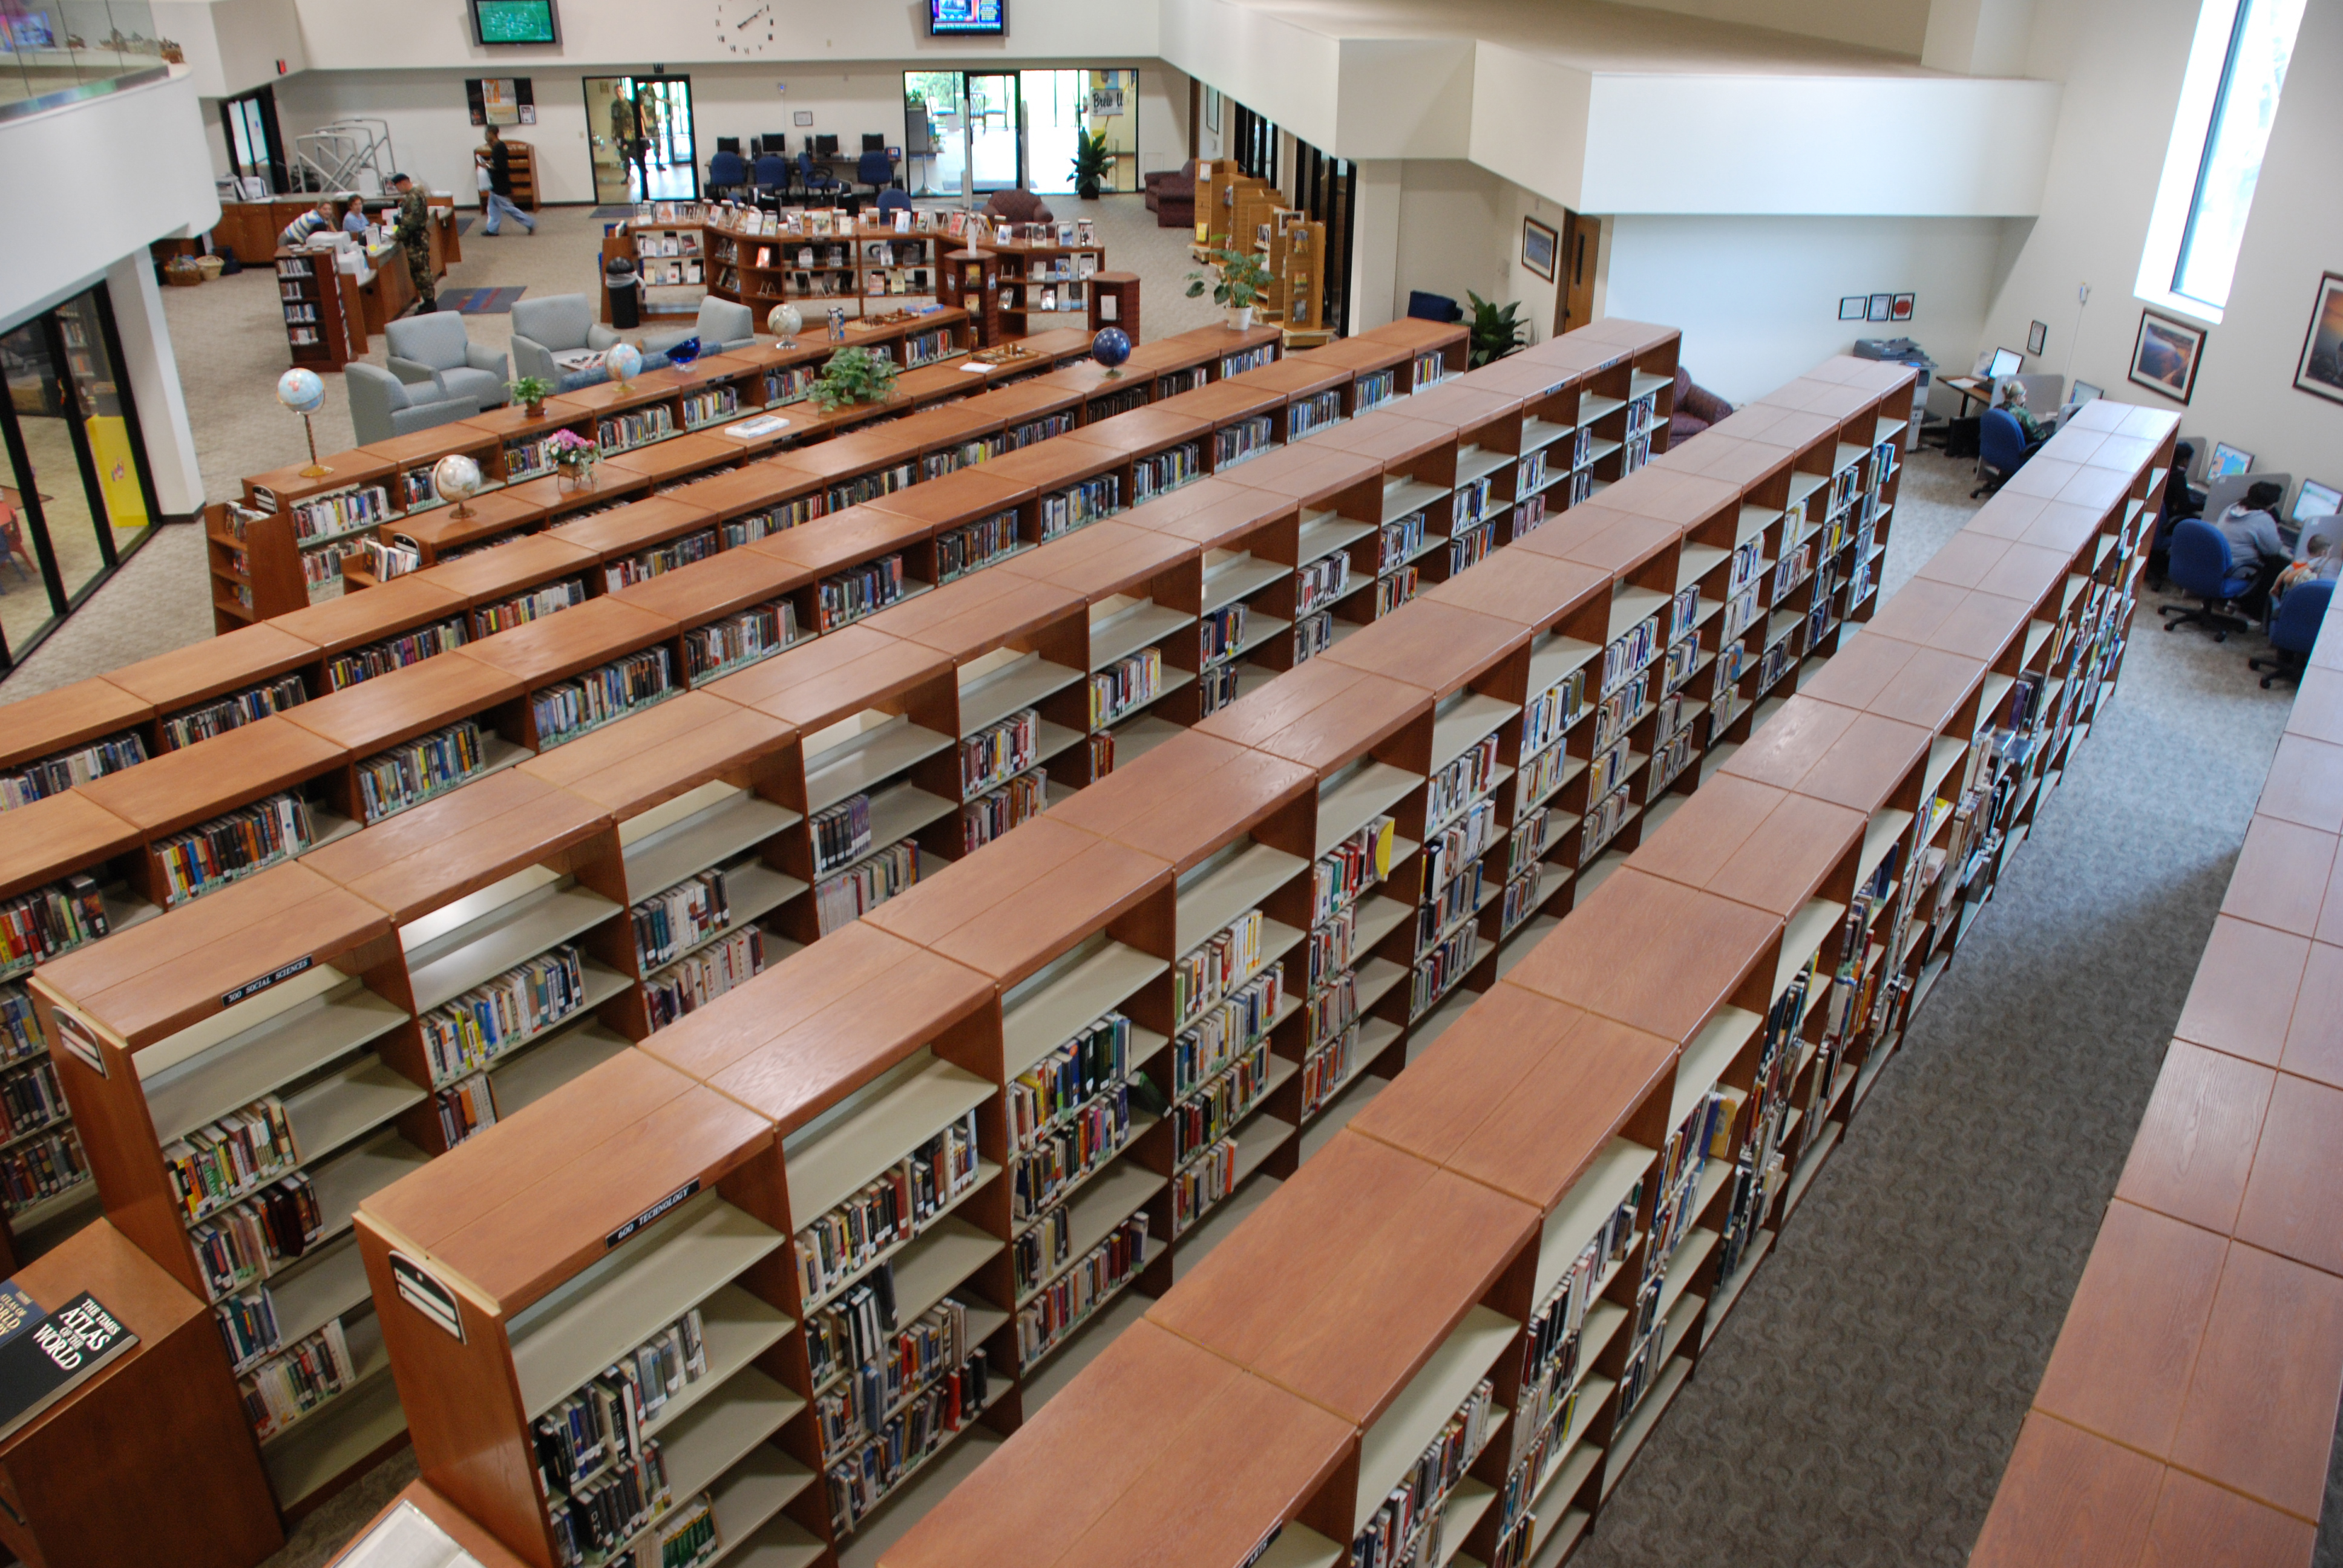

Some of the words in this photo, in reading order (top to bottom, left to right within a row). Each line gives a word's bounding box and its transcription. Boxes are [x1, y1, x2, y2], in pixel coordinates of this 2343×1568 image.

[1092, 93, 1113, 108] Brew
[228, 990, 242, 1003] 300
[246, 976, 272, 994] SOCIAL
[275, 958, 309, 981] SCIENCES
[206, 1170, 219, 1197] ISLAM
[618, 1223, 634, 1240] 600
[638, 1186, 689, 1226] TECHNOLOGY
[1, 1293, 19, 1311] ATLAS
[15, 1307, 28, 1318] OF
[81, 1298, 102, 1318] THE
[96, 1312, 122, 1336] TIMES
[32, 1323, 83, 1371] WORLD
[59, 1307, 113, 1351] ATLAS
[59, 1326, 73, 1339] OF
[67, 1332, 85, 1350] THE
[591, 1510, 604, 1544] DNA
